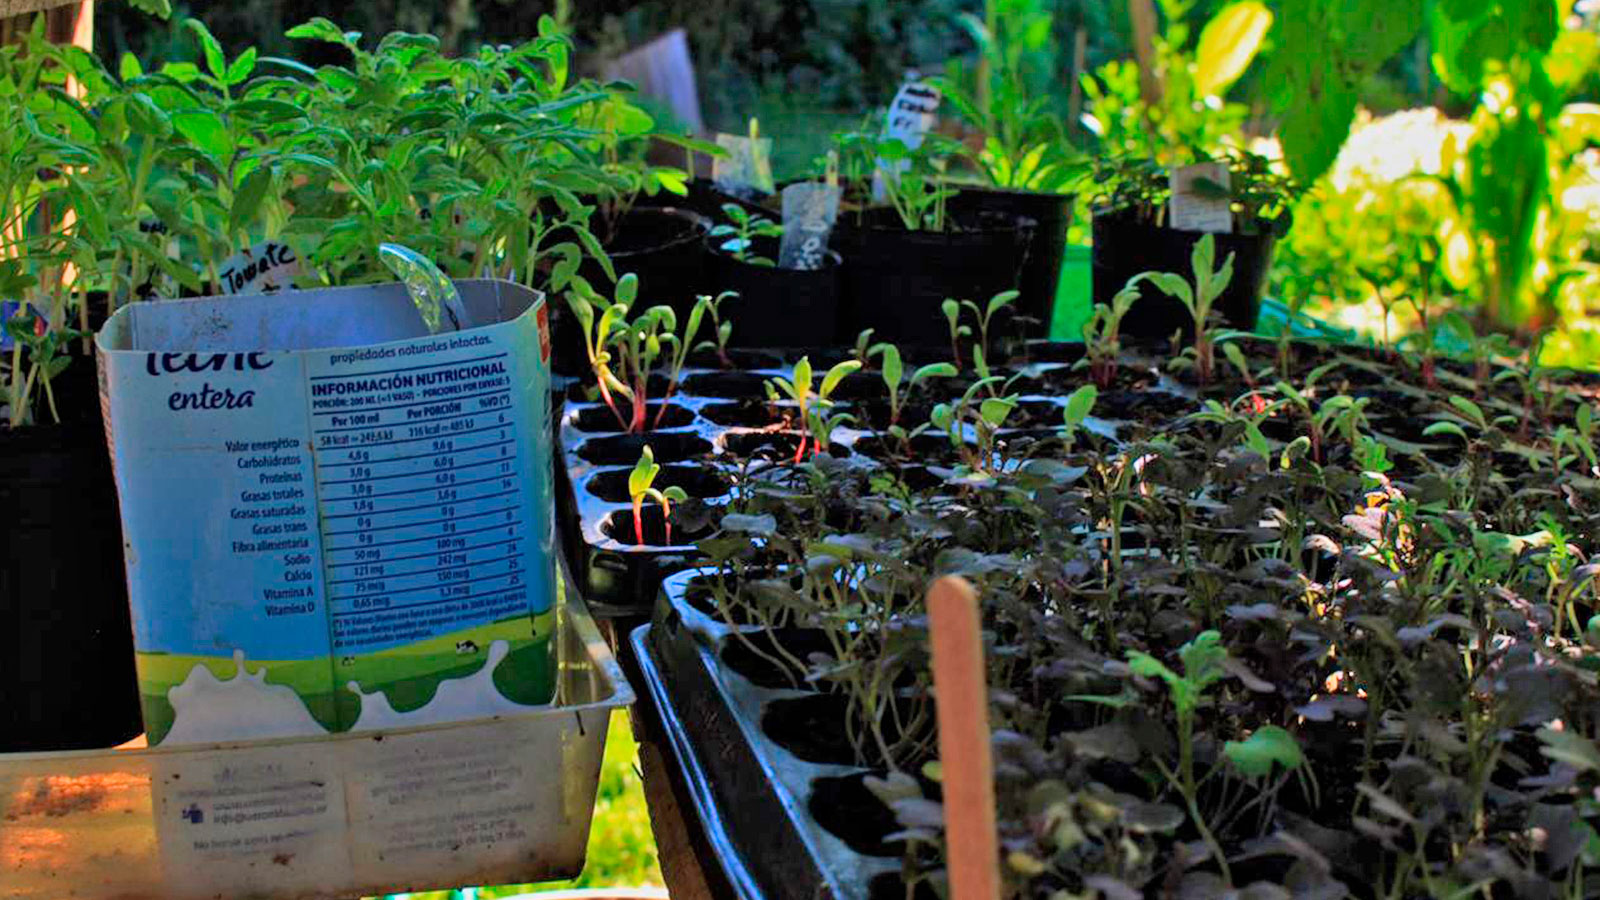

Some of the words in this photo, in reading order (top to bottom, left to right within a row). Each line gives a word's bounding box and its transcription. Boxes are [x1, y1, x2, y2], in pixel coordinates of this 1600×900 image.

[330, 348, 396, 366] propiedades
[311, 373, 414, 397] INFORMACIÓN
[416, 361, 507, 388] NUTRICIONAL
[168, 382, 256, 411] entera
[498, 413, 505, 423] 6
[225, 440, 249, 452] Valor
[237, 455, 301, 469] Carbohidratos
[241, 490, 271, 502] Grasas
[273, 487, 304, 500] totales
[230, 508, 260, 519] Grasas
[252, 523, 282, 535] Grasas
[284, 522, 308, 533] trans
[232, 541, 255, 553] Fibra
[257, 537, 309, 551] alimentaria
[284, 553, 312, 566] Sodio
[284, 570, 313, 582] Calcio
[263, 588, 305, 600] Vitamina
[306, 586, 314, 597] A
[264, 603, 306, 616] Vitamina
[308, 602, 315, 613] D
